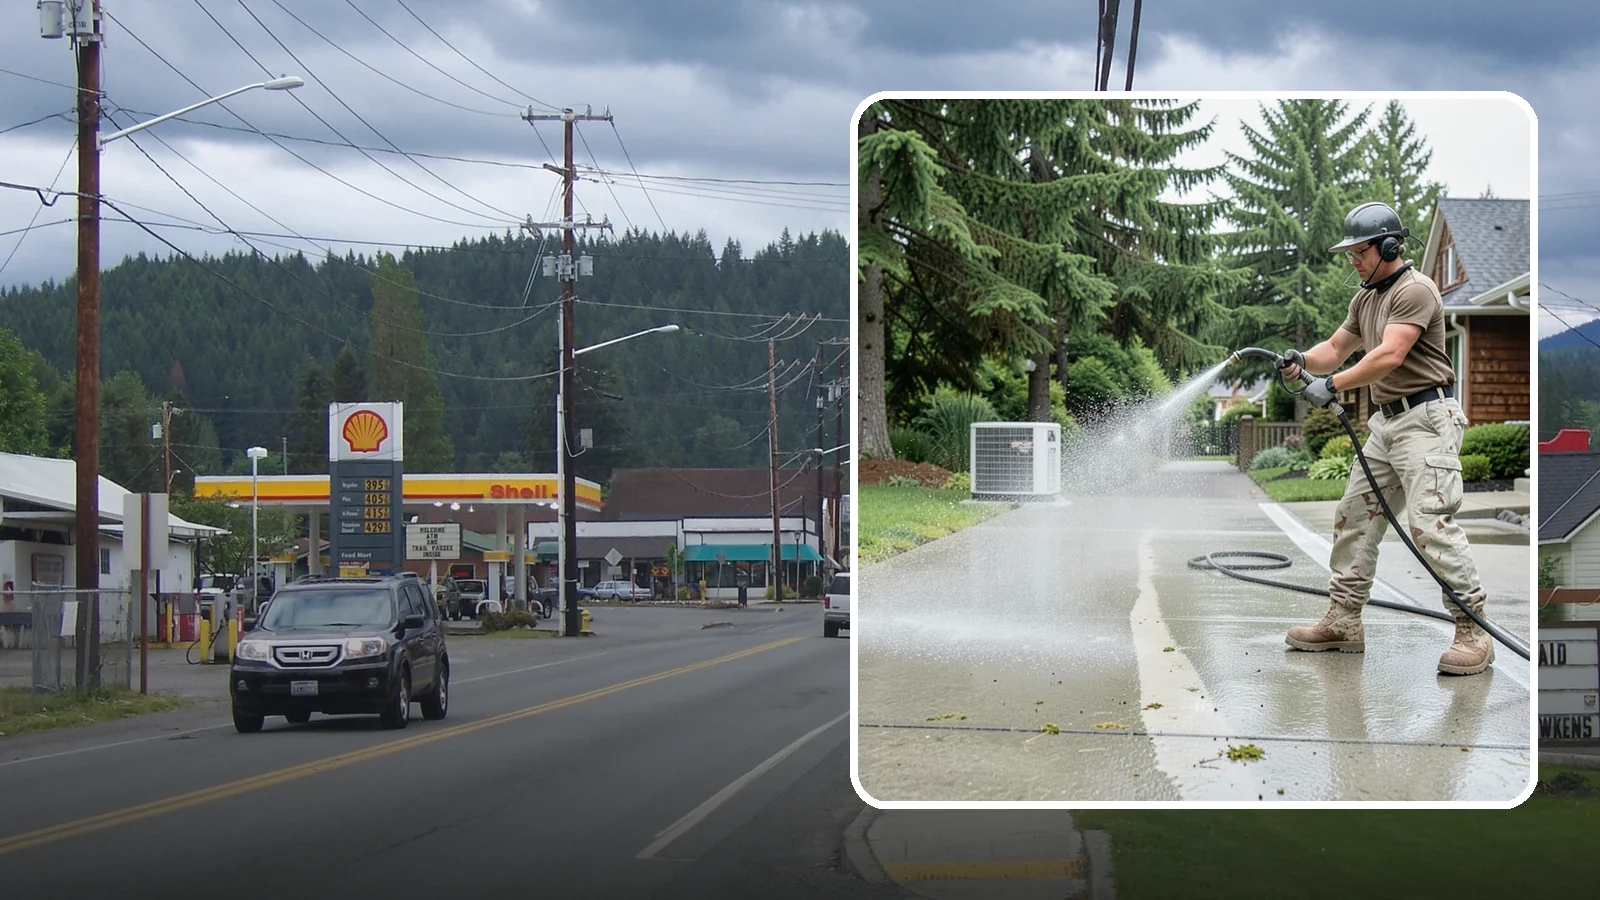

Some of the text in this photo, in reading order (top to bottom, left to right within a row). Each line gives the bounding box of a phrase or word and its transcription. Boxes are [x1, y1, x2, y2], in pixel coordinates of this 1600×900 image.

[365, 480, 384, 490] 395
[490, 484, 548, 499] Shell
[365, 494, 384, 504] 405
[365, 508, 384, 518] 415
[365, 522, 384, 533] 429
